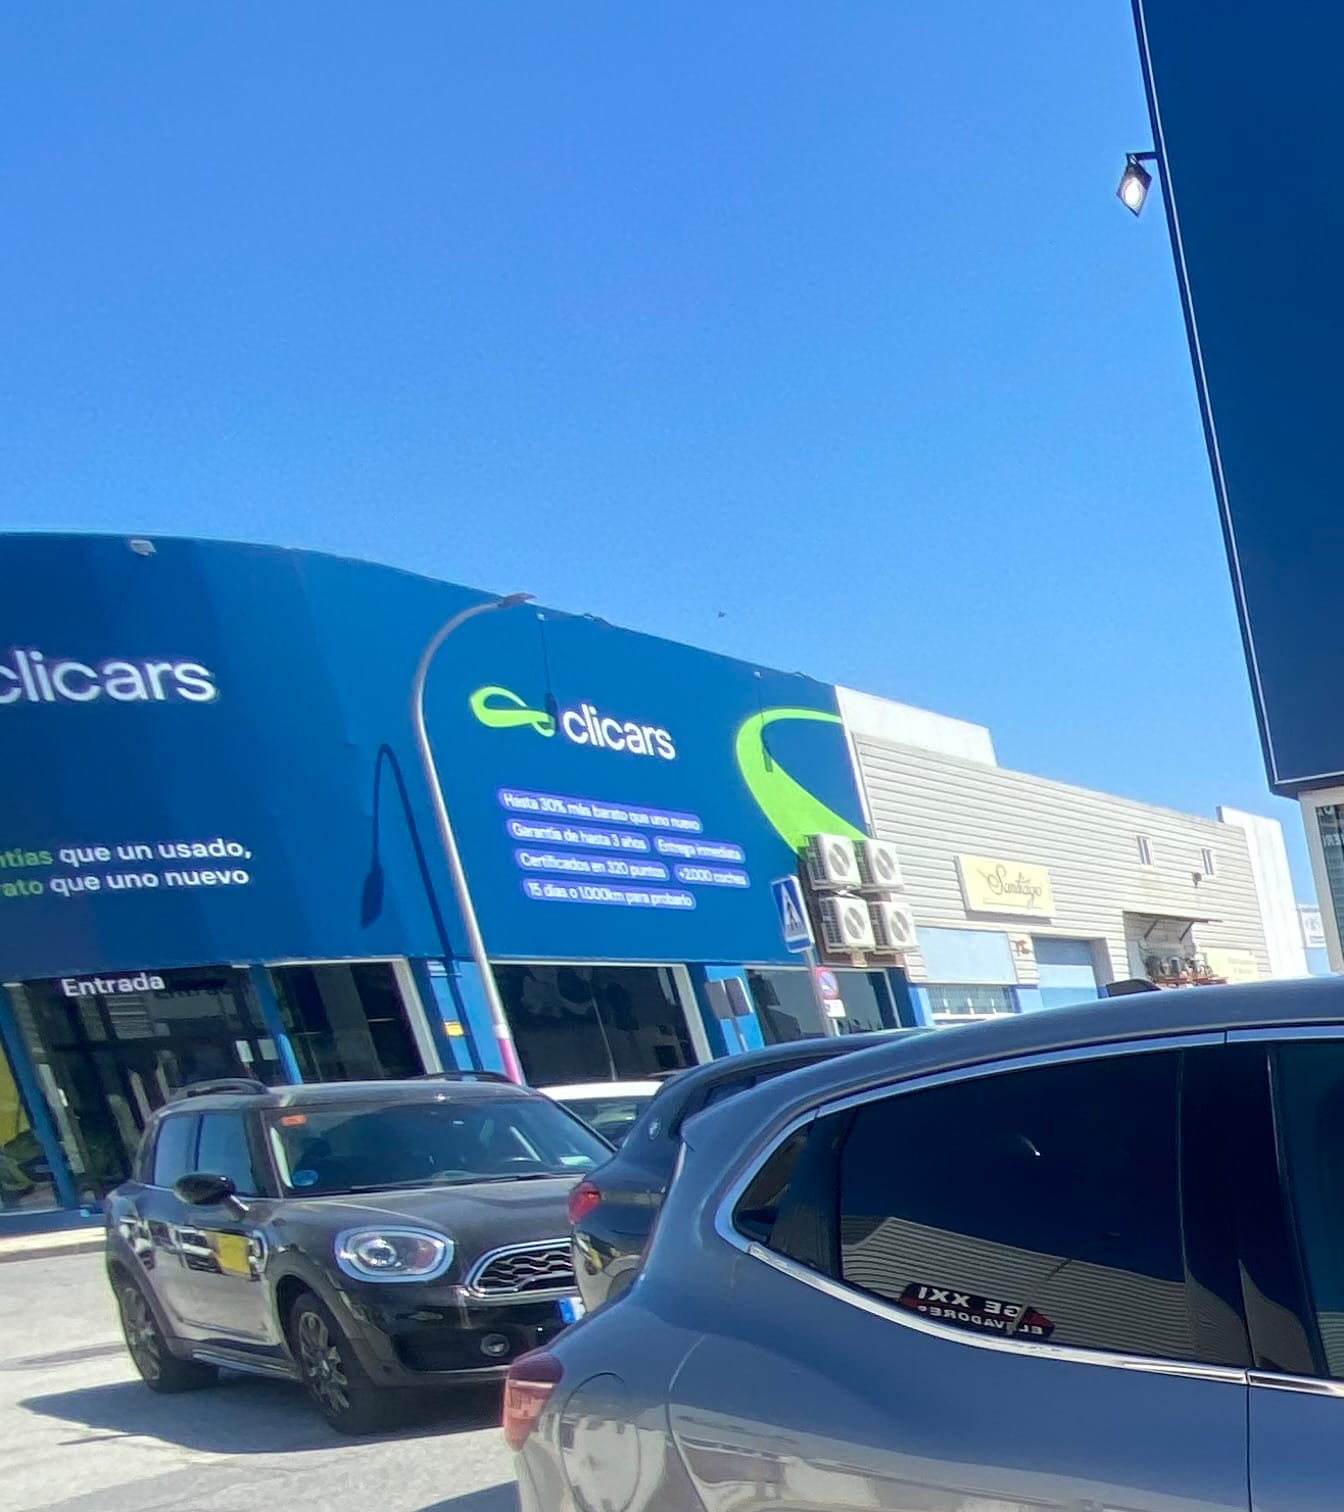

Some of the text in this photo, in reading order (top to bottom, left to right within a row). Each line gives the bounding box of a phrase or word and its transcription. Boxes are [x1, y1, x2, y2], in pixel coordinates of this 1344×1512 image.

[563, 704, 675, 760] clicars
[564, 828, 579, 843] de
[612, 835, 620, 847] 3
[59, 847, 110, 867] que
[117, 844, 152, 860] un
[158, 838, 252, 859] usado,
[592, 859, 606, 872] en
[0, 869, 249, 897] ato que uno nuevo
[61, 972, 166, 997] Entrada
